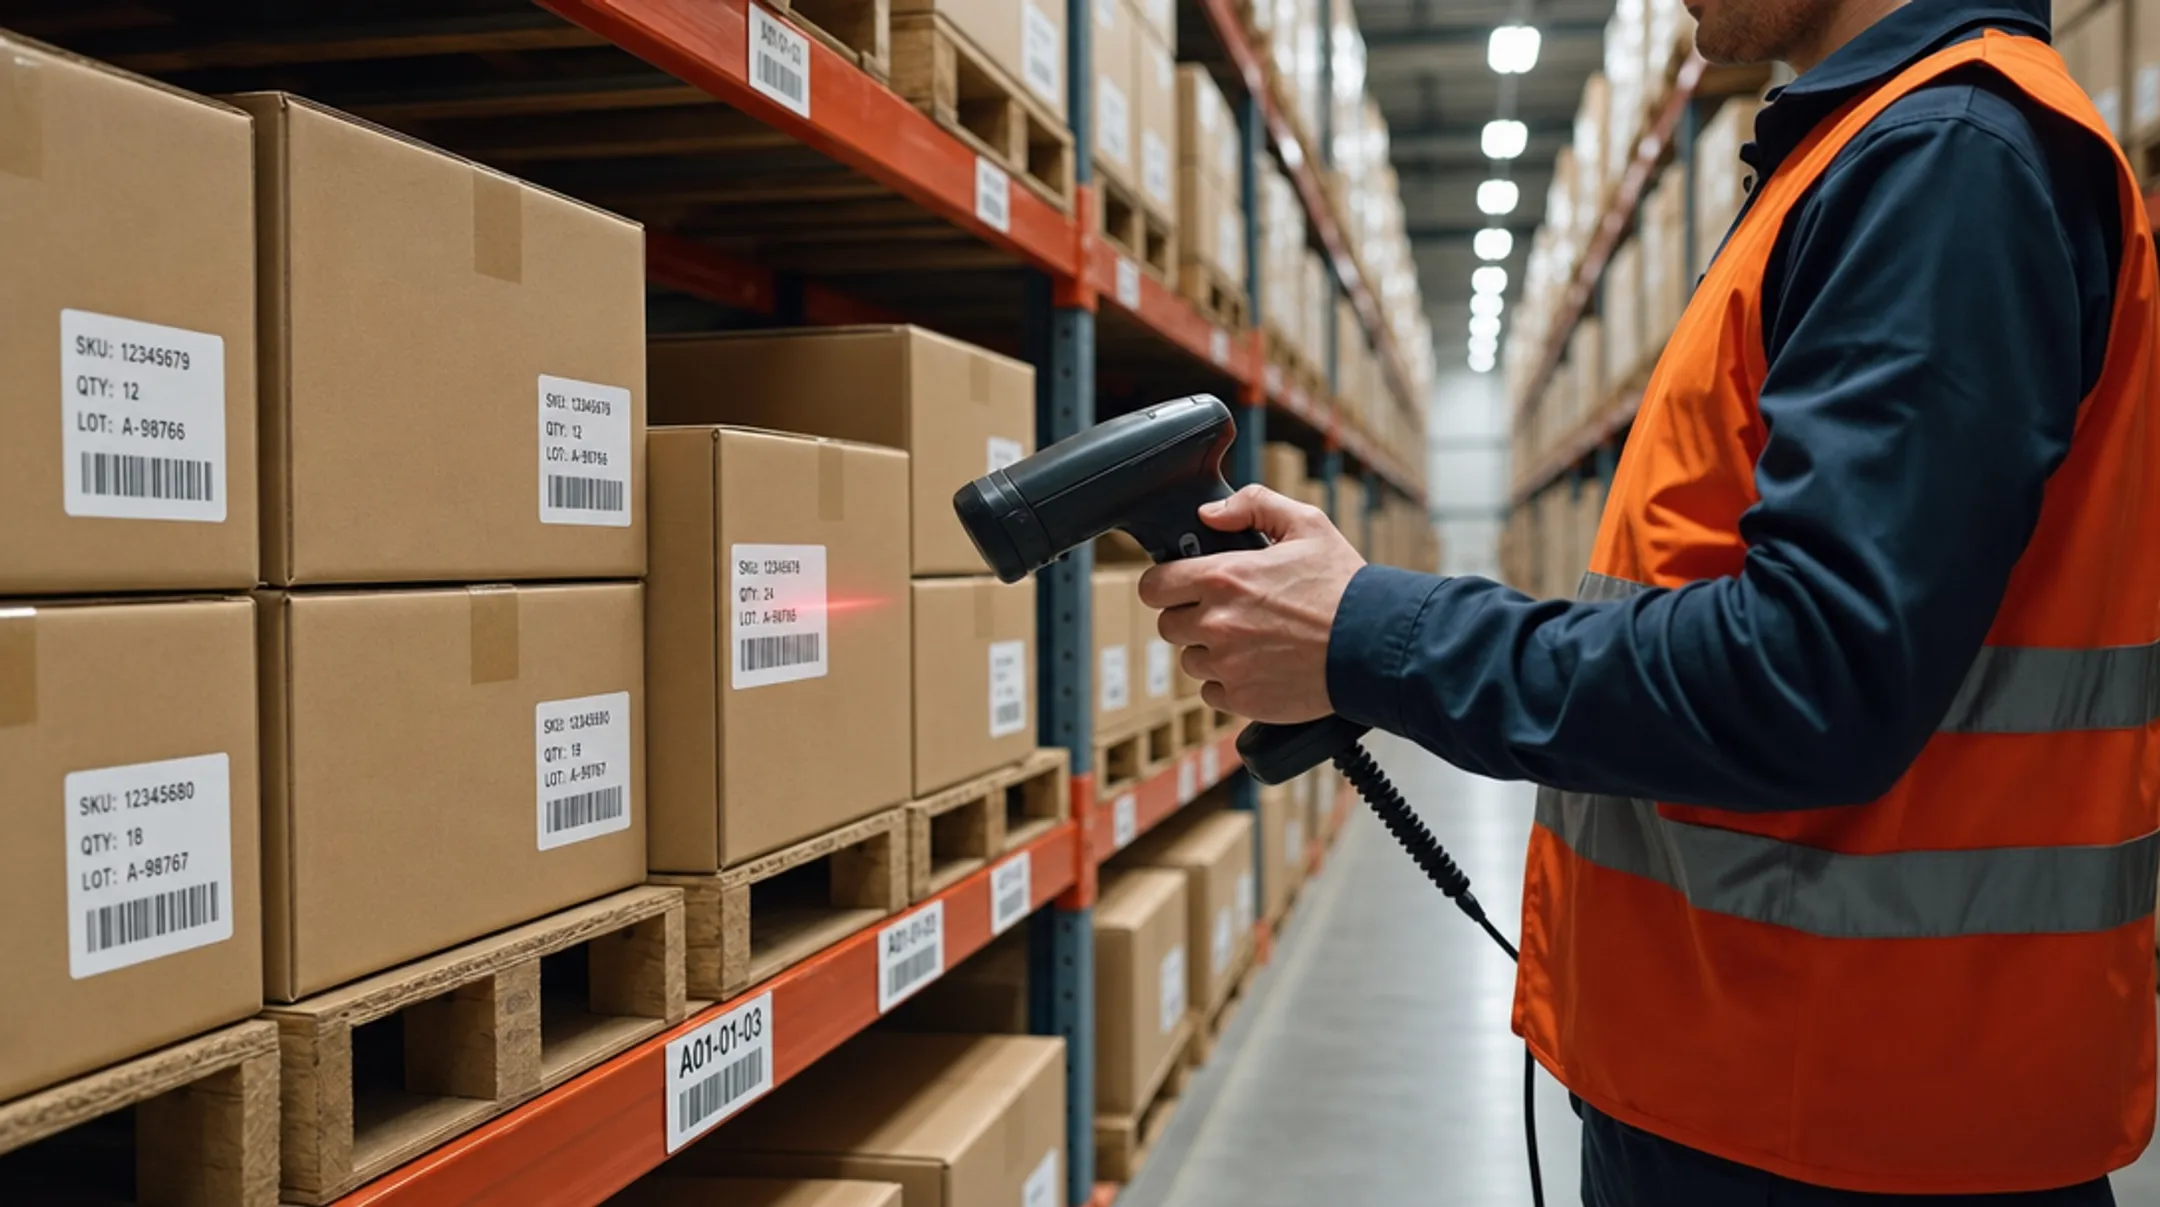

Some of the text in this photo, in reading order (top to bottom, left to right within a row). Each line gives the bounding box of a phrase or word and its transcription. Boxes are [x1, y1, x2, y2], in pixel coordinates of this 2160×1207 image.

[76, 335, 190, 370] SKU: 12345679
[77, 375, 139, 400] QTY: 12
[77, 412, 185, 440] LOT: A-98766
[79, 781, 195, 816] SKU: 12345680
[81, 827, 143, 855] QTY: 18
[82, 852, 189, 891] LOT: A-98767
[679, 1007, 762, 1079] A01-01-03
